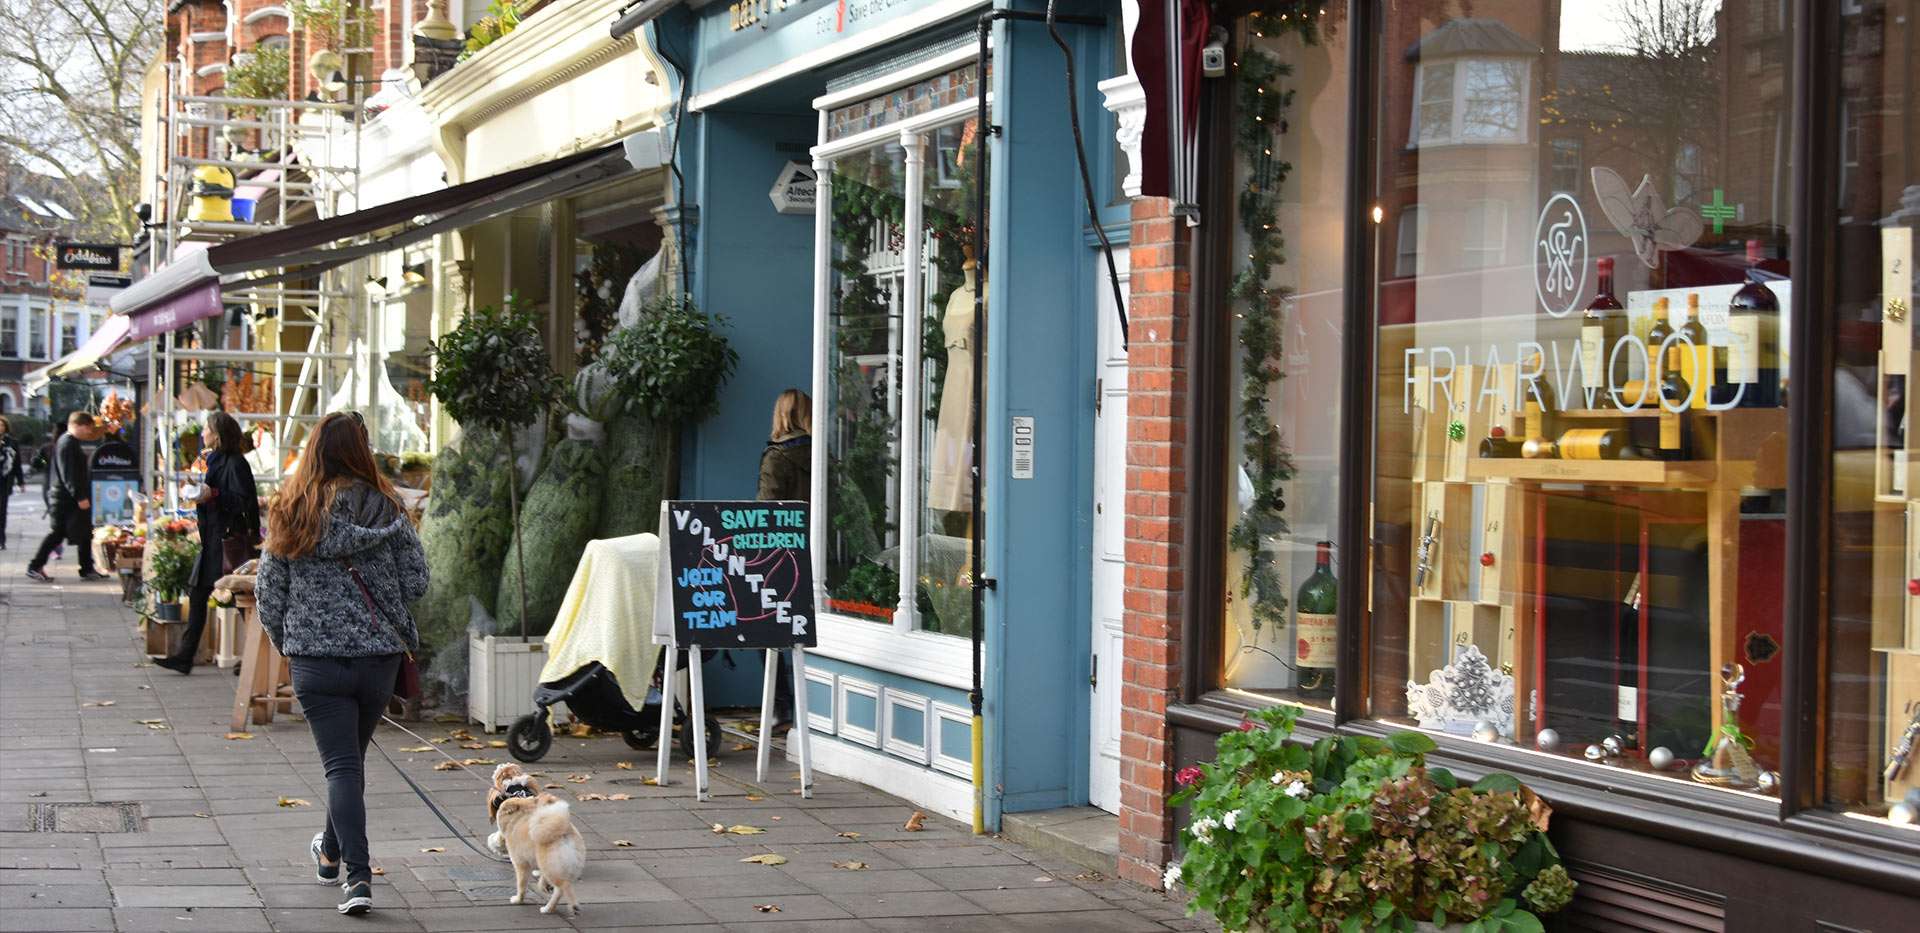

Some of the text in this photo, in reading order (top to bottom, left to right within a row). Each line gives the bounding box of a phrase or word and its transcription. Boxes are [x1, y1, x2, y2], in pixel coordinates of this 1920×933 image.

[1404, 334, 1746, 414] FRIARWOOD
[720, 509, 805, 529] SAVE THE
[732, 532, 805, 549] CHILDREN
[673, 510, 808, 636] VOLUNTEER
[677, 567, 724, 588] JOIN
[691, 590, 726, 608] OUR
[682, 610, 737, 629] TEAM
[1456, 631, 1468, 643] 19
